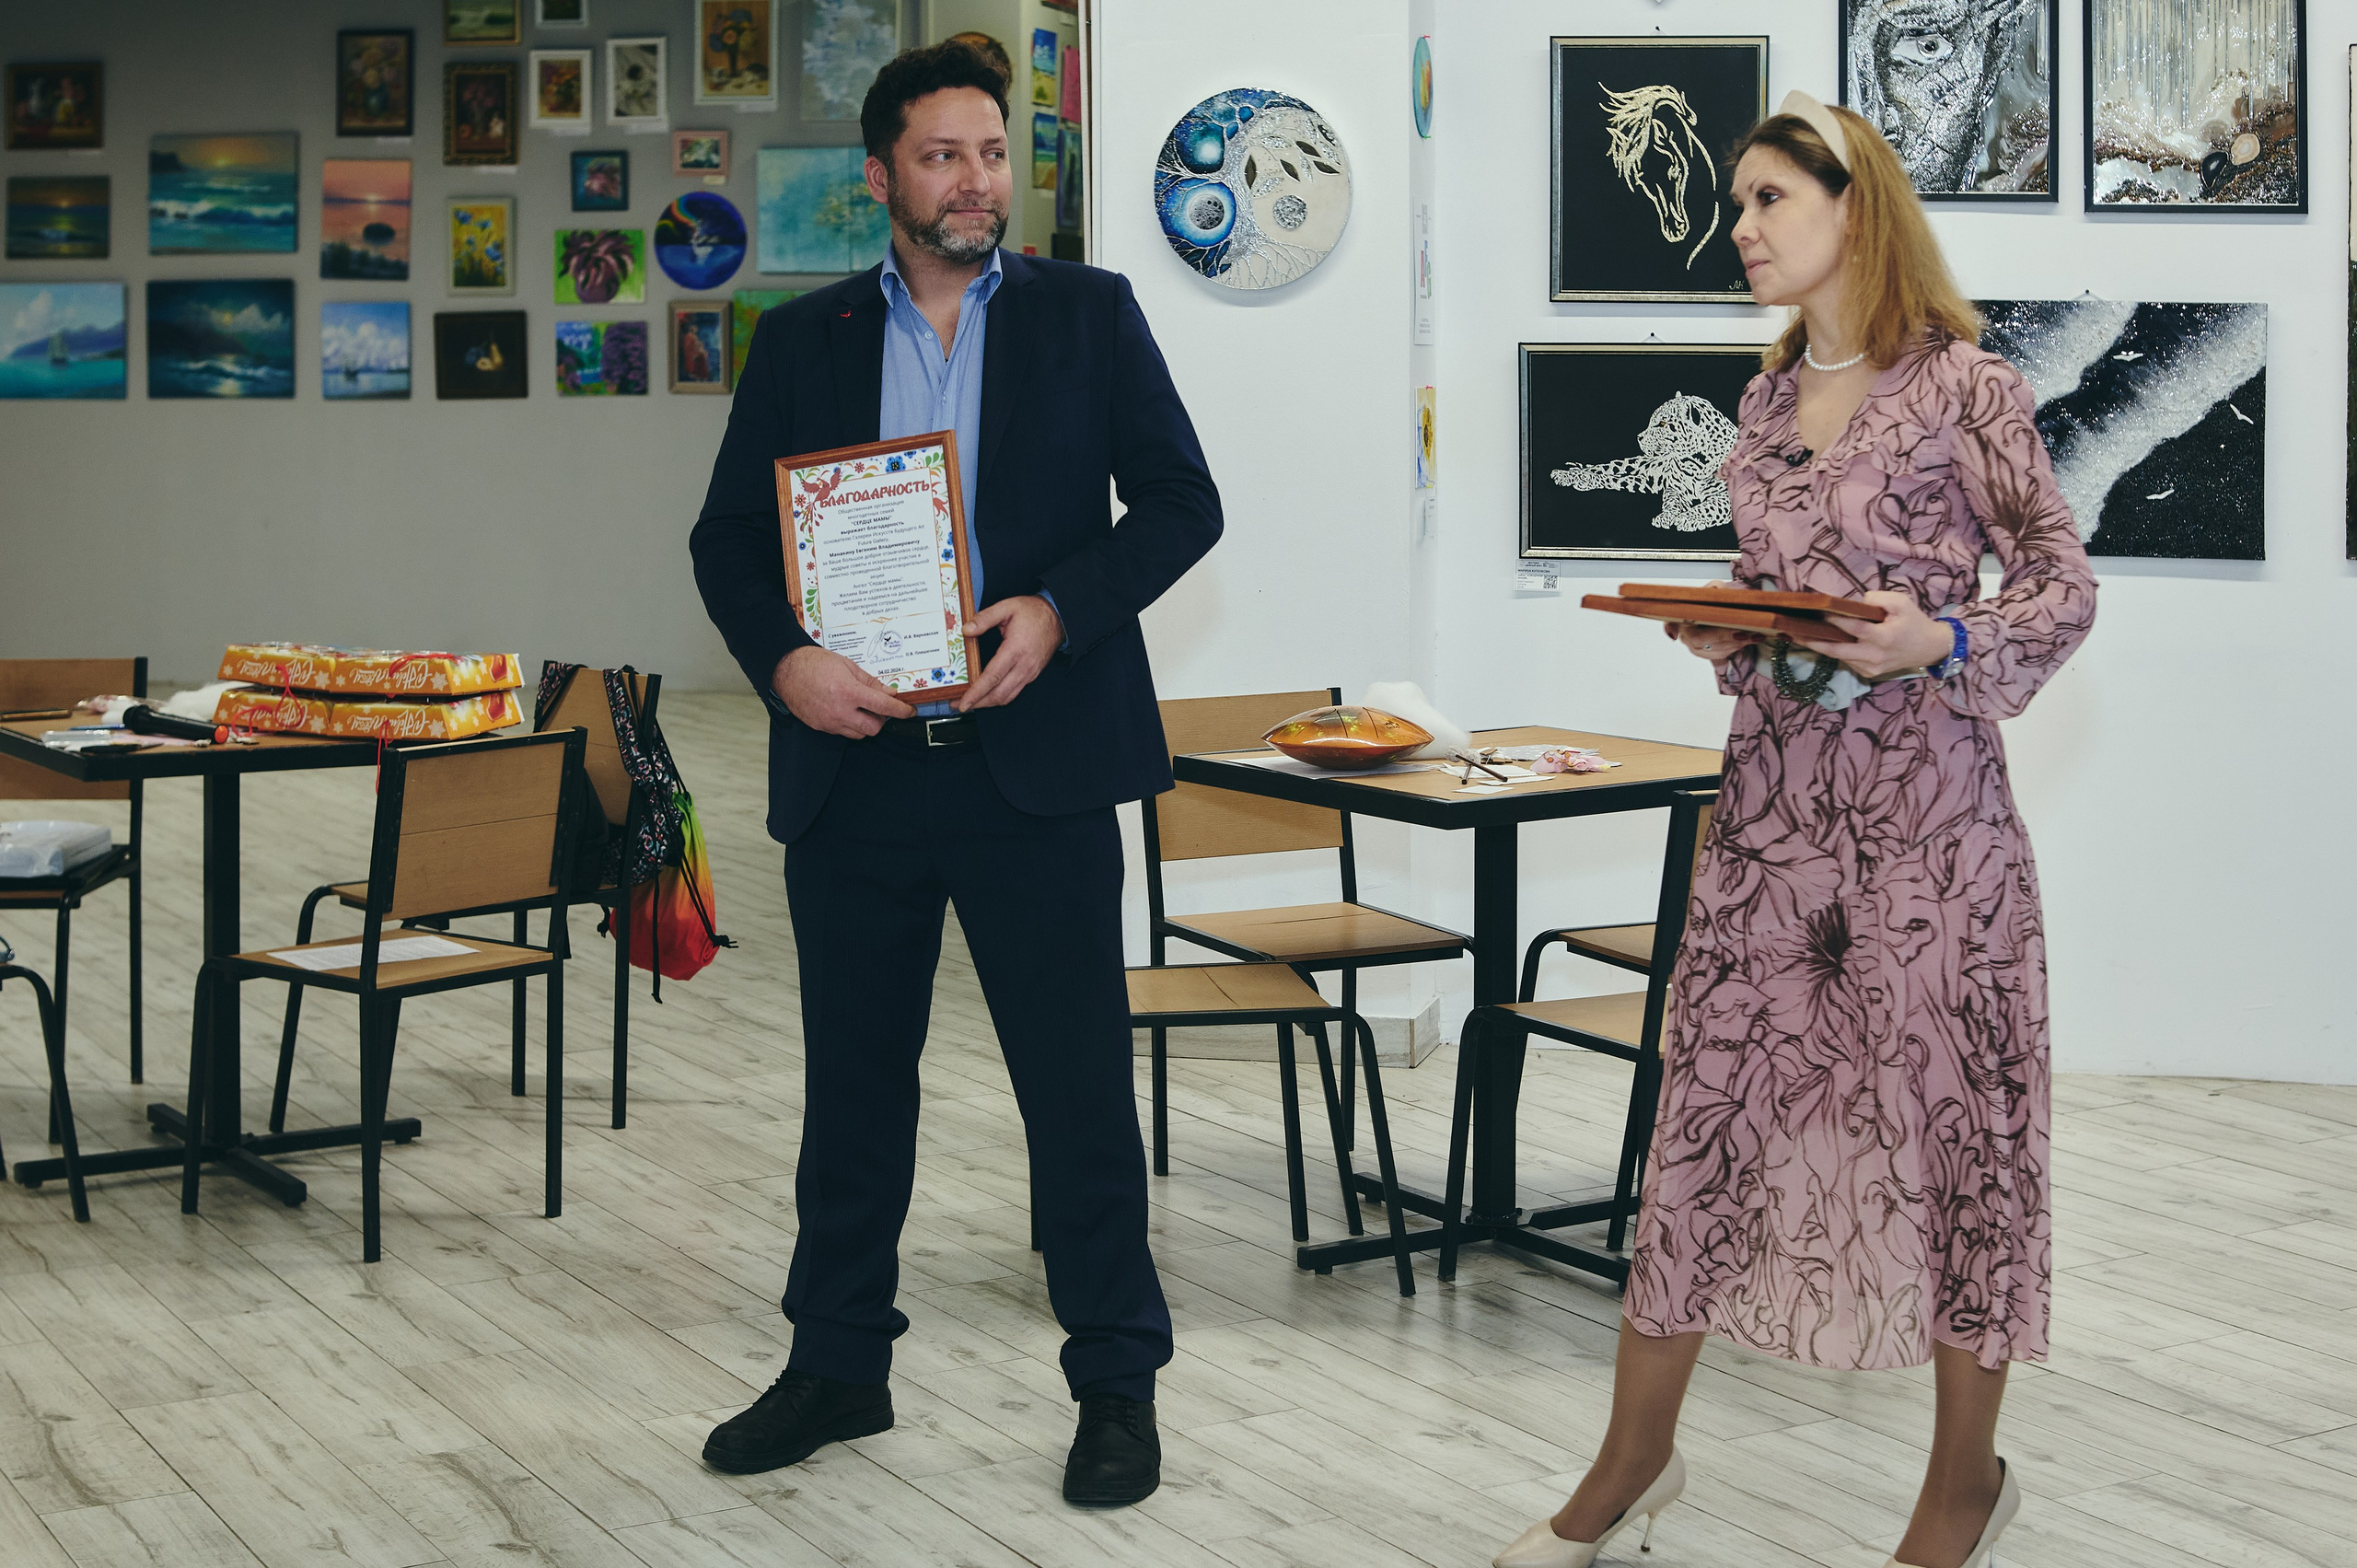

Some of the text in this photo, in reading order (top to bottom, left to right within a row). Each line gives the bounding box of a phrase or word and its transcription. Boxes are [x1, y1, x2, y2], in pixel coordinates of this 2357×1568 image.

[819, 480, 930, 508] БЛАГОДАРНОСТЬ
[837, 505, 873, 515] Общественная
[840, 521, 904, 535] выражает благодарность
[877, 540, 920, 550] Владимировичу
[823, 572, 849, 580] совместно
[849, 565, 882, 575] проведенной
